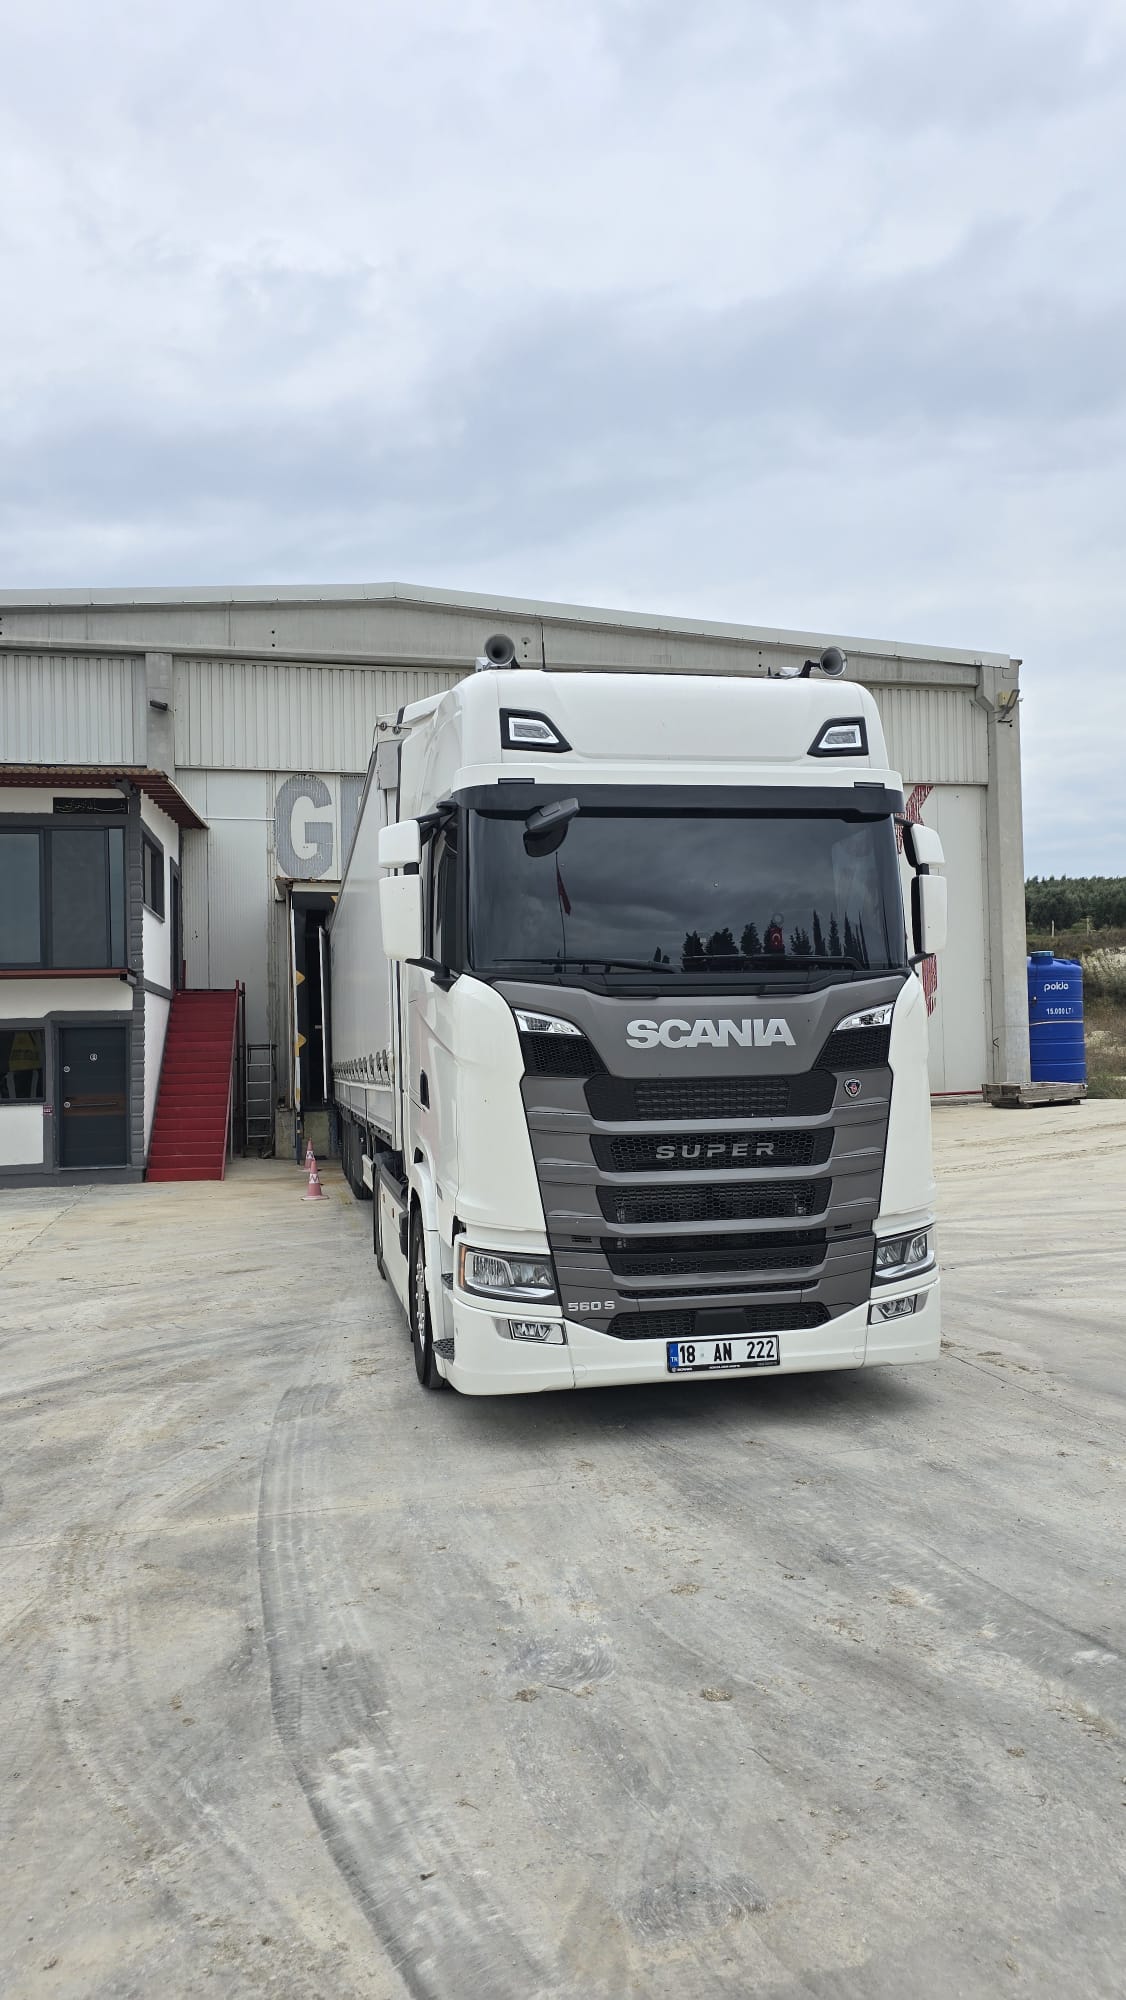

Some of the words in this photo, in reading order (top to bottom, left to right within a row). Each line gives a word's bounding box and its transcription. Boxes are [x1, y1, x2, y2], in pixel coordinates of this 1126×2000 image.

[625, 1018, 797, 1049] SCANIA
[655, 1142, 775, 1159] SUPER
[567, 1301, 601, 1312] 560
[604, 1300, 616, 1311] S
[679, 1344, 696, 1364] 18
[713, 1342, 732, 1362] AN
[746, 1340, 775, 1360] 222
